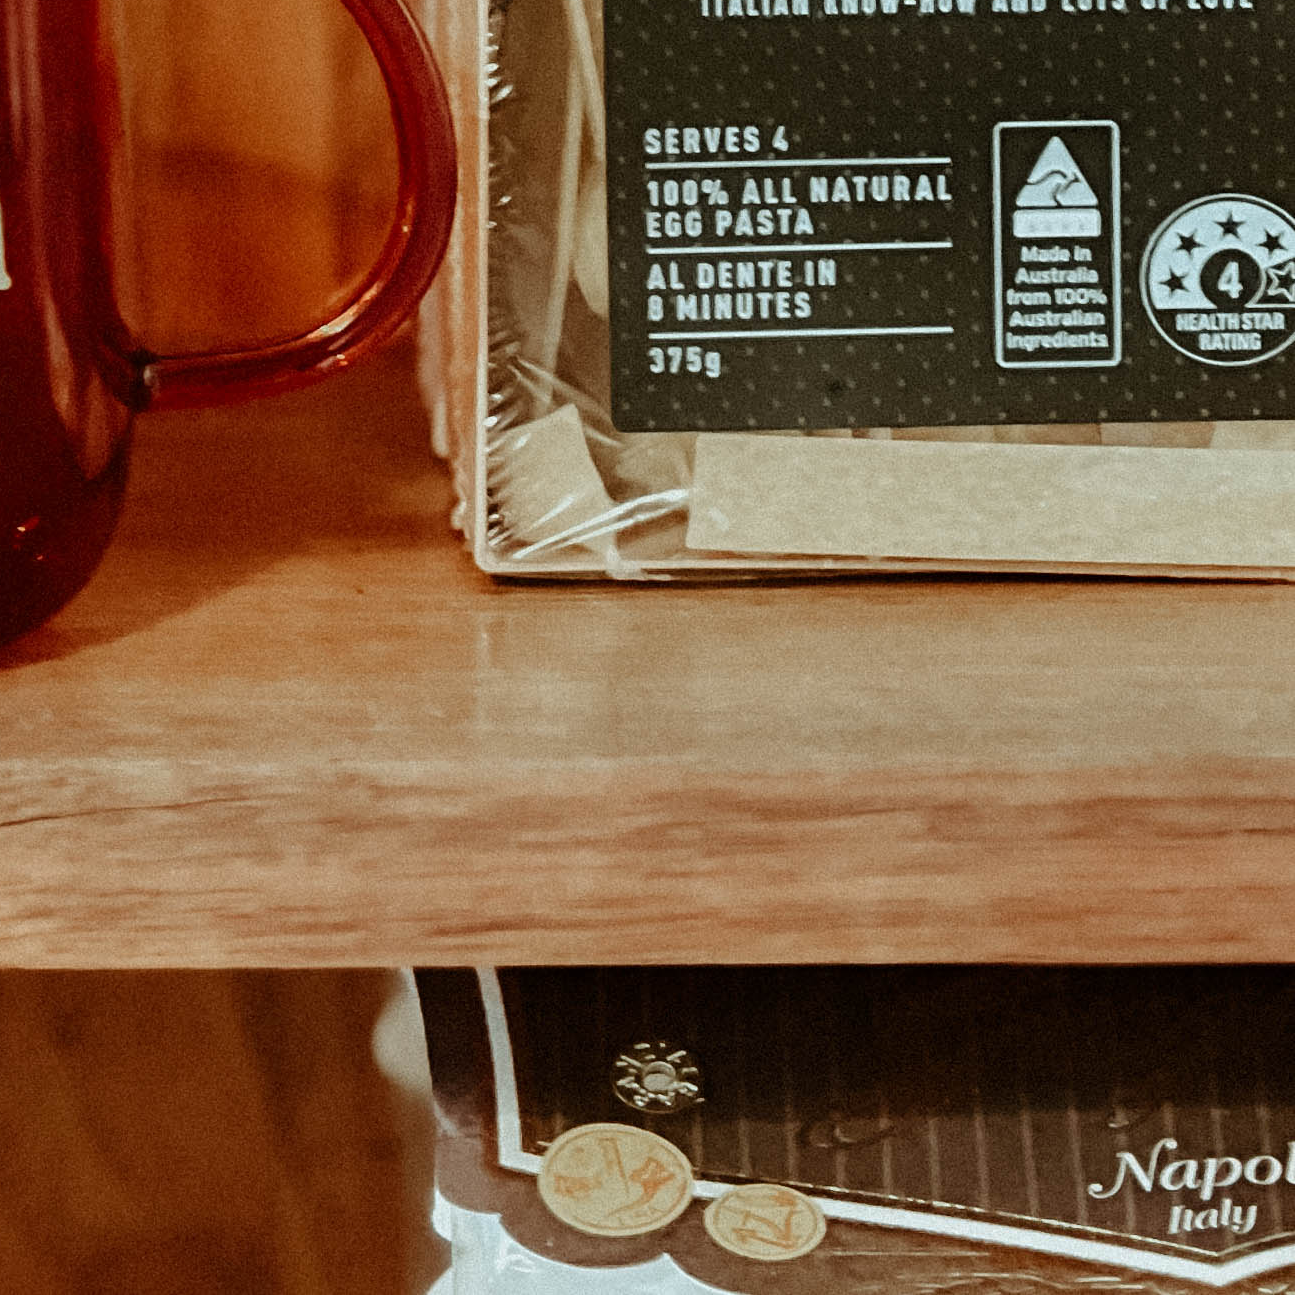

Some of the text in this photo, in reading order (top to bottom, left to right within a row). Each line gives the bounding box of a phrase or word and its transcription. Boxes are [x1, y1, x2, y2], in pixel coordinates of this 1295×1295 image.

[645, 125, 789, 155] SERVES 4
[647, 174, 952, 207] 100% ALL NATURAL
[646, 208, 814, 238] EGG PASTA
[1020, 245, 1093, 262] Made in
[647, 259, 836, 290] AL DENTE IN
[1014, 267, 1100, 284] Australia
[1217, 261, 1245, 300] 4
[648, 291, 811, 322] 8 MINUTES
[1054, 288, 1108, 305] 100%
[1008, 309, 1106, 327] Australian
[1175, 312, 1286, 331] HEALTH STAR
[1198, 332, 1262, 351] RATING
[649, 346, 721, 378] 375g
[1167, 1197, 1258, 1235] Italy
